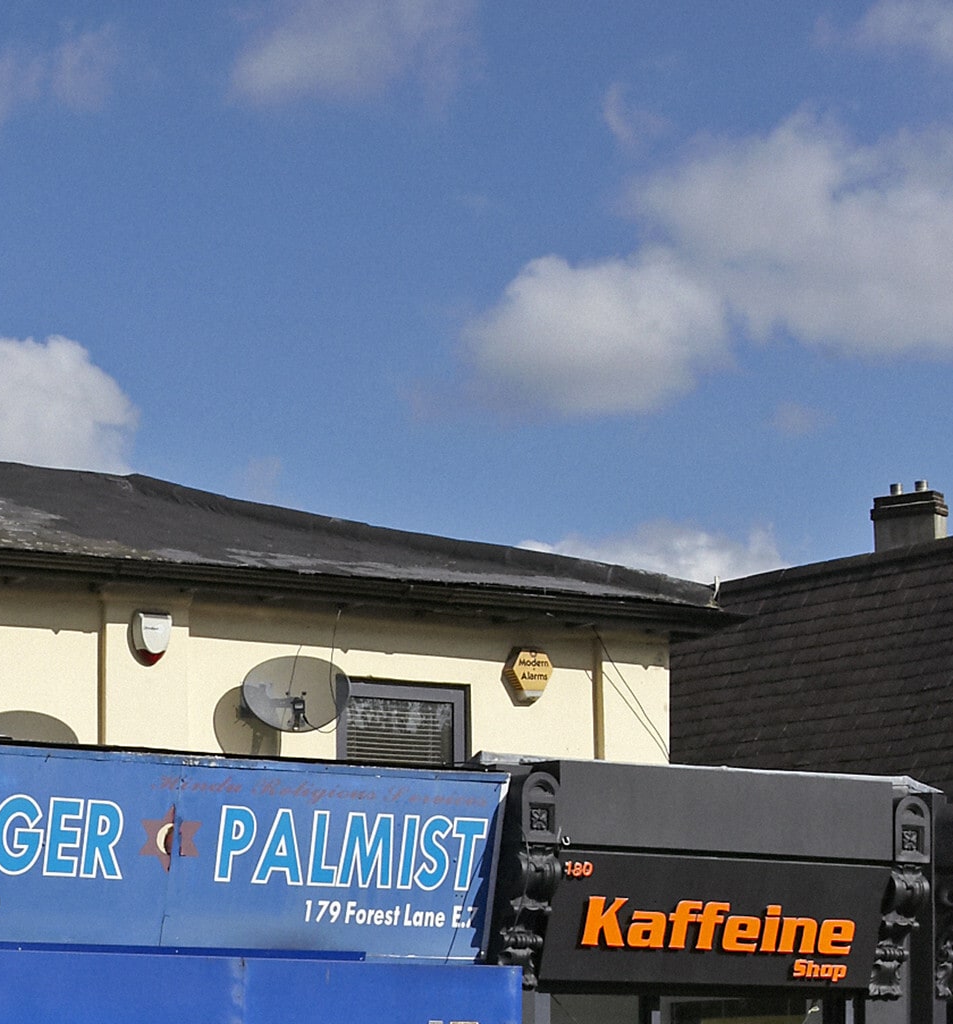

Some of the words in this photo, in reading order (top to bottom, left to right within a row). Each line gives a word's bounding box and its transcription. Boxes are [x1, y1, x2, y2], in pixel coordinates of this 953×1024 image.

[518, 659, 549, 667] Modern
[521, 671, 548, 680] Alarms
[214, 804, 489, 892] PALMIST
[564, 860, 594, 878] 180
[304, 899, 341, 923] 179
[344, 900, 400, 926] Forest
[403, 903, 446, 928] Lane
[580, 894, 857, 957] Kaffeine
[792, 957, 848, 983] Shop
